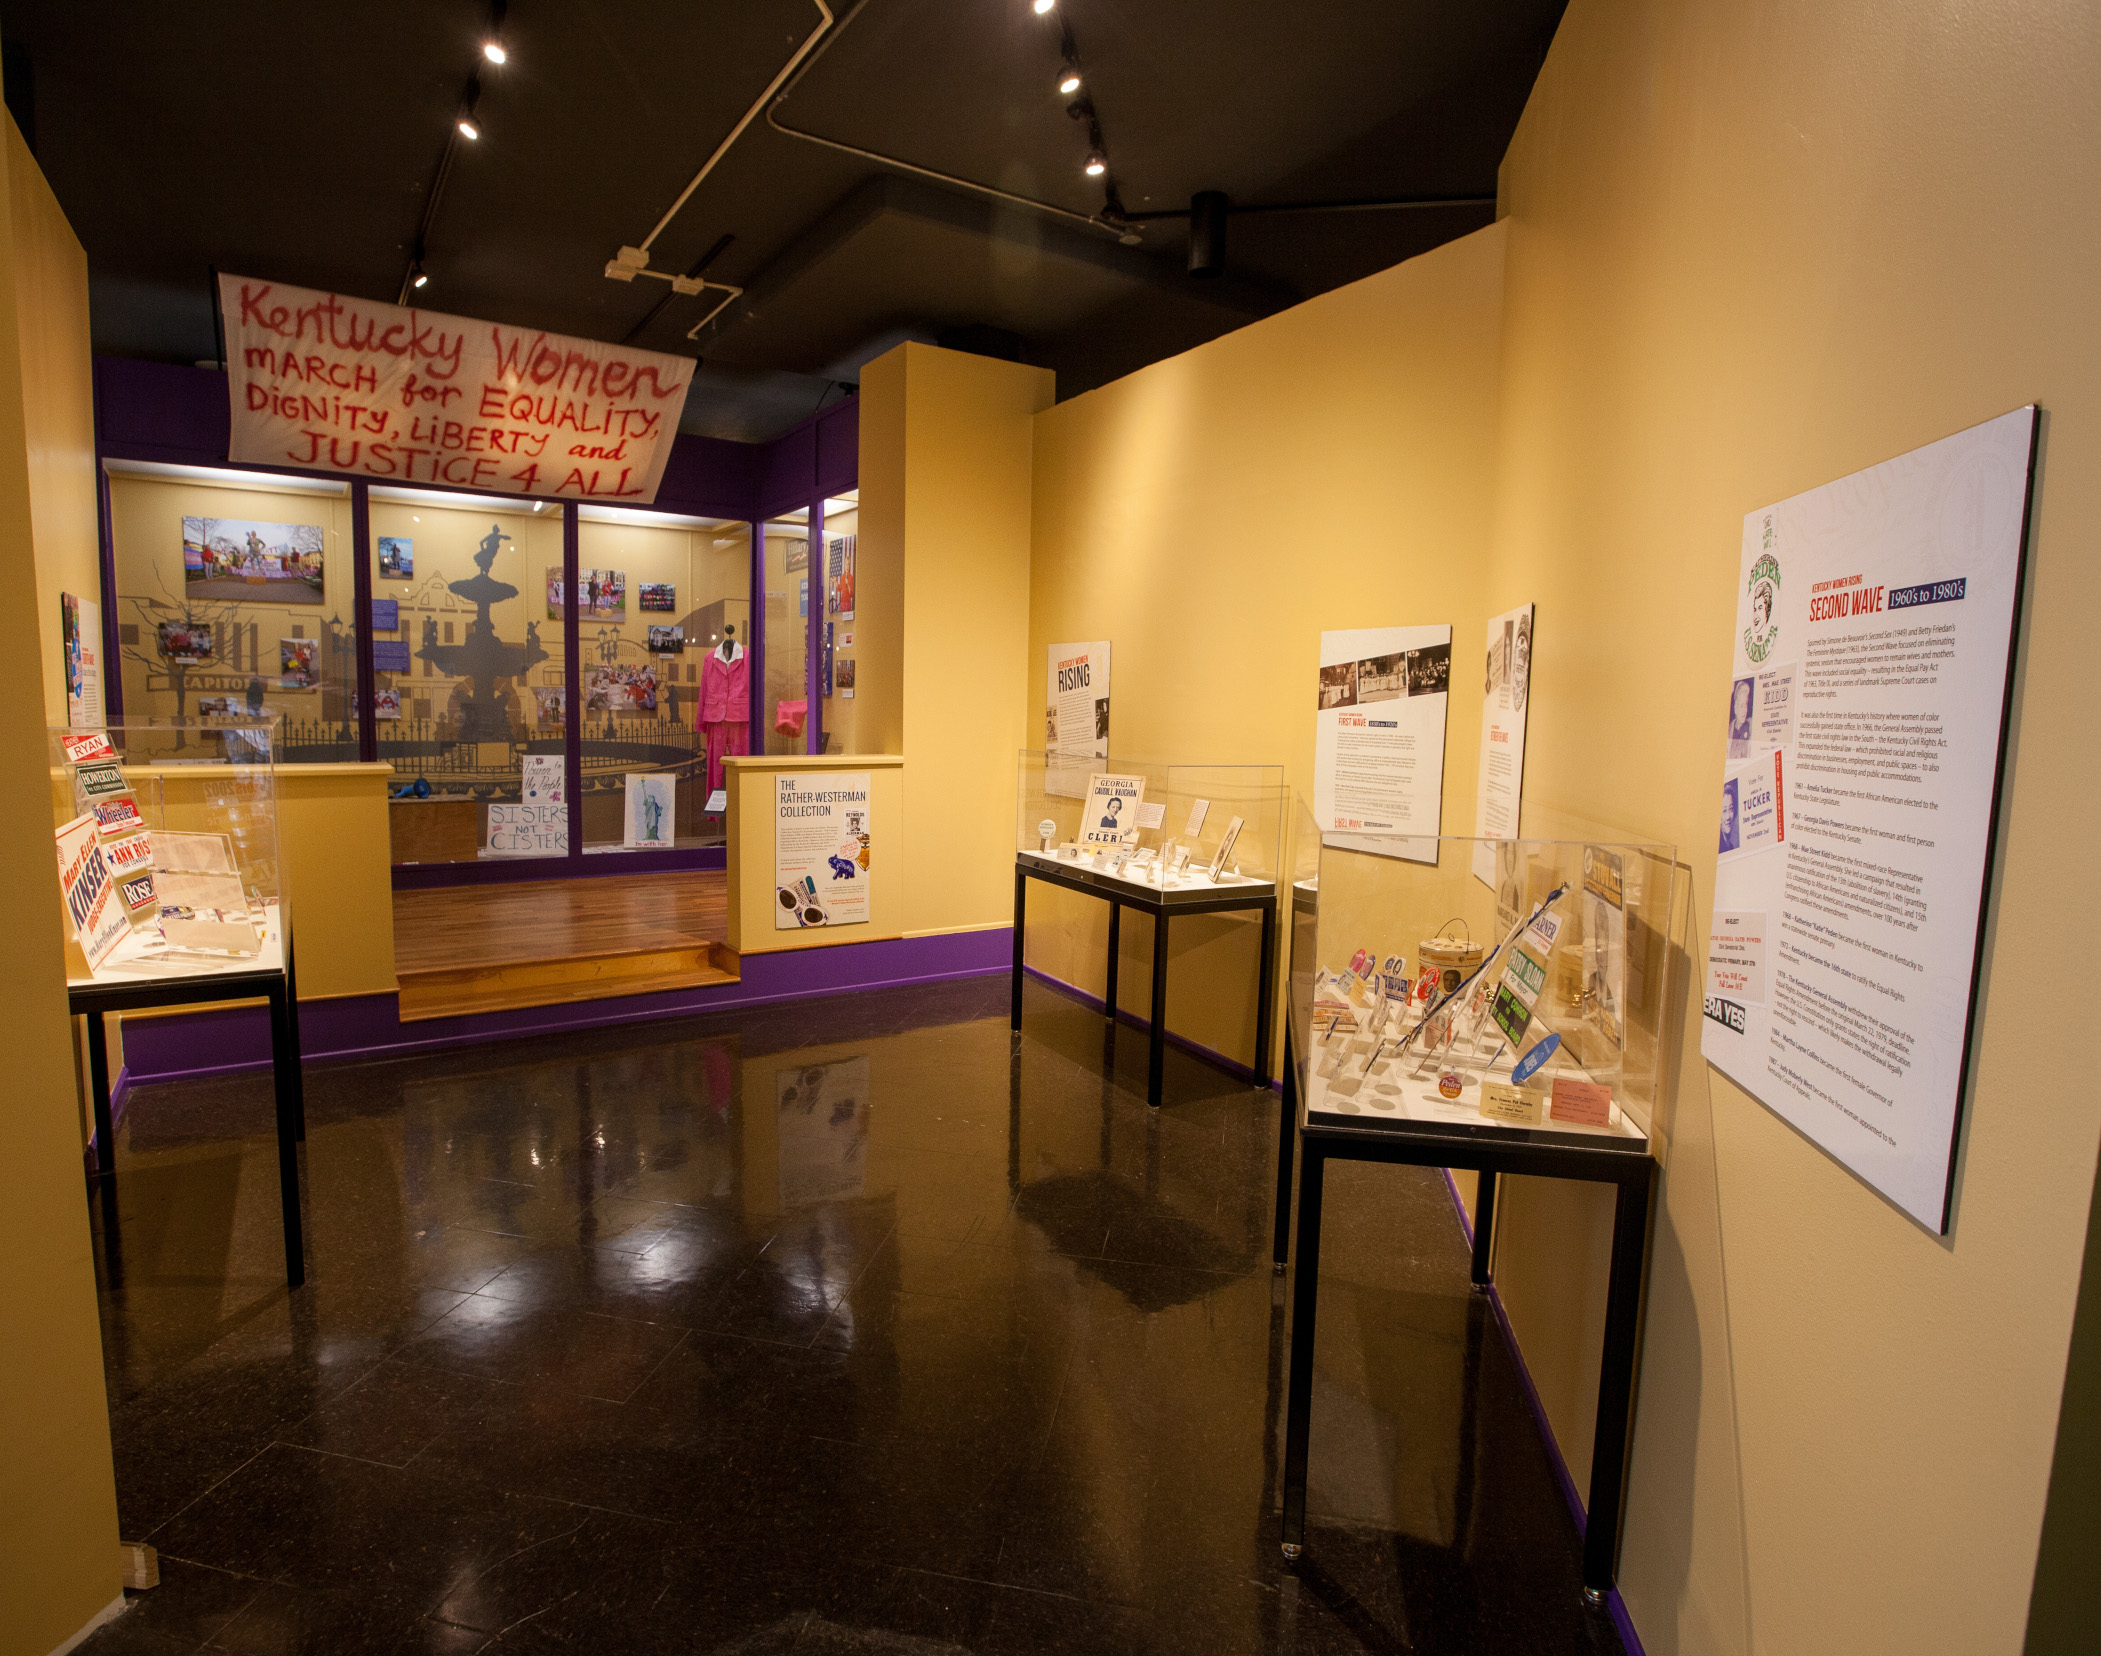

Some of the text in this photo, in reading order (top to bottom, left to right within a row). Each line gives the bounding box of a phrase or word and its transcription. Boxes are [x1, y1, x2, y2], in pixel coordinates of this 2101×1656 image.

[240, 282, 683, 400] Kentucky Women
[402, 374, 462, 409] for
[567, 440, 628, 462] and
[509, 465, 542, 494] 4
[555, 467, 643, 497] ALL
[1748, 562, 1781, 597] PEDEN
[1812, 573, 1863, 594] KENTUCKY WOMEN RISING
[1809, 580, 1964, 622] SECOND WAVE 1960's to 1980's
[1908, 626, 1918, 636] and
[1918, 626, 1932, 636] Betty
[1898, 639, 1917, 649] focused
[1925, 637, 1955, 647] eliminating
[1907, 652, 1920, 660] wives
[1921, 650, 1931, 659] and
[1905, 662, 1938, 674] Equal Pay Act
[1058, 663, 1090, 692] RISING
[1880, 677, 1900, 687] Supreme
[1901, 676, 1915, 685] Court
[1764, 687, 1788, 704] KIDD
[1338, 717, 1352, 726] FIRST
[1353, 718, 1366, 727] WAVE
[1882, 724, 1943, 735] General Assembly passed
[74, 736, 103, 757] RYAN
[1887, 736, 1908, 746] Kentucky
[1920, 737, 1937, 748] Rights
[1916, 750, 1938, 760] religious
[81, 769, 120, 785] HOWERTON
[538, 776, 563, 790] People
[780, 780, 796, 791] THE
[1100, 780, 1133, 788] GEORGIA
[780, 791, 866, 804] RATHER-WESTERMAN
[1743, 791, 1771, 811] TUCKER
[1865, 792, 1939, 810] African American elected to the
[96, 803, 135, 825] Wheeler
[491, 805, 568, 824] SISTERS
[780, 805, 831, 818] COLLECTION
[515, 825, 538, 834] NOT
[1896, 834, 1906, 842] and
[1916, 838, 1935, 848] person
[63, 831, 97, 895] MARY ELLEN
[113, 846, 134, 865] ANN
[68, 846, 107, 932] KINSER
[1894, 954, 1917, 971] Kentucky
[1524, 961, 1545, 992] SLOAN
[1704, 997, 1746, 1031] ERA YES
[1441, 1079, 1461, 1089] Peden
